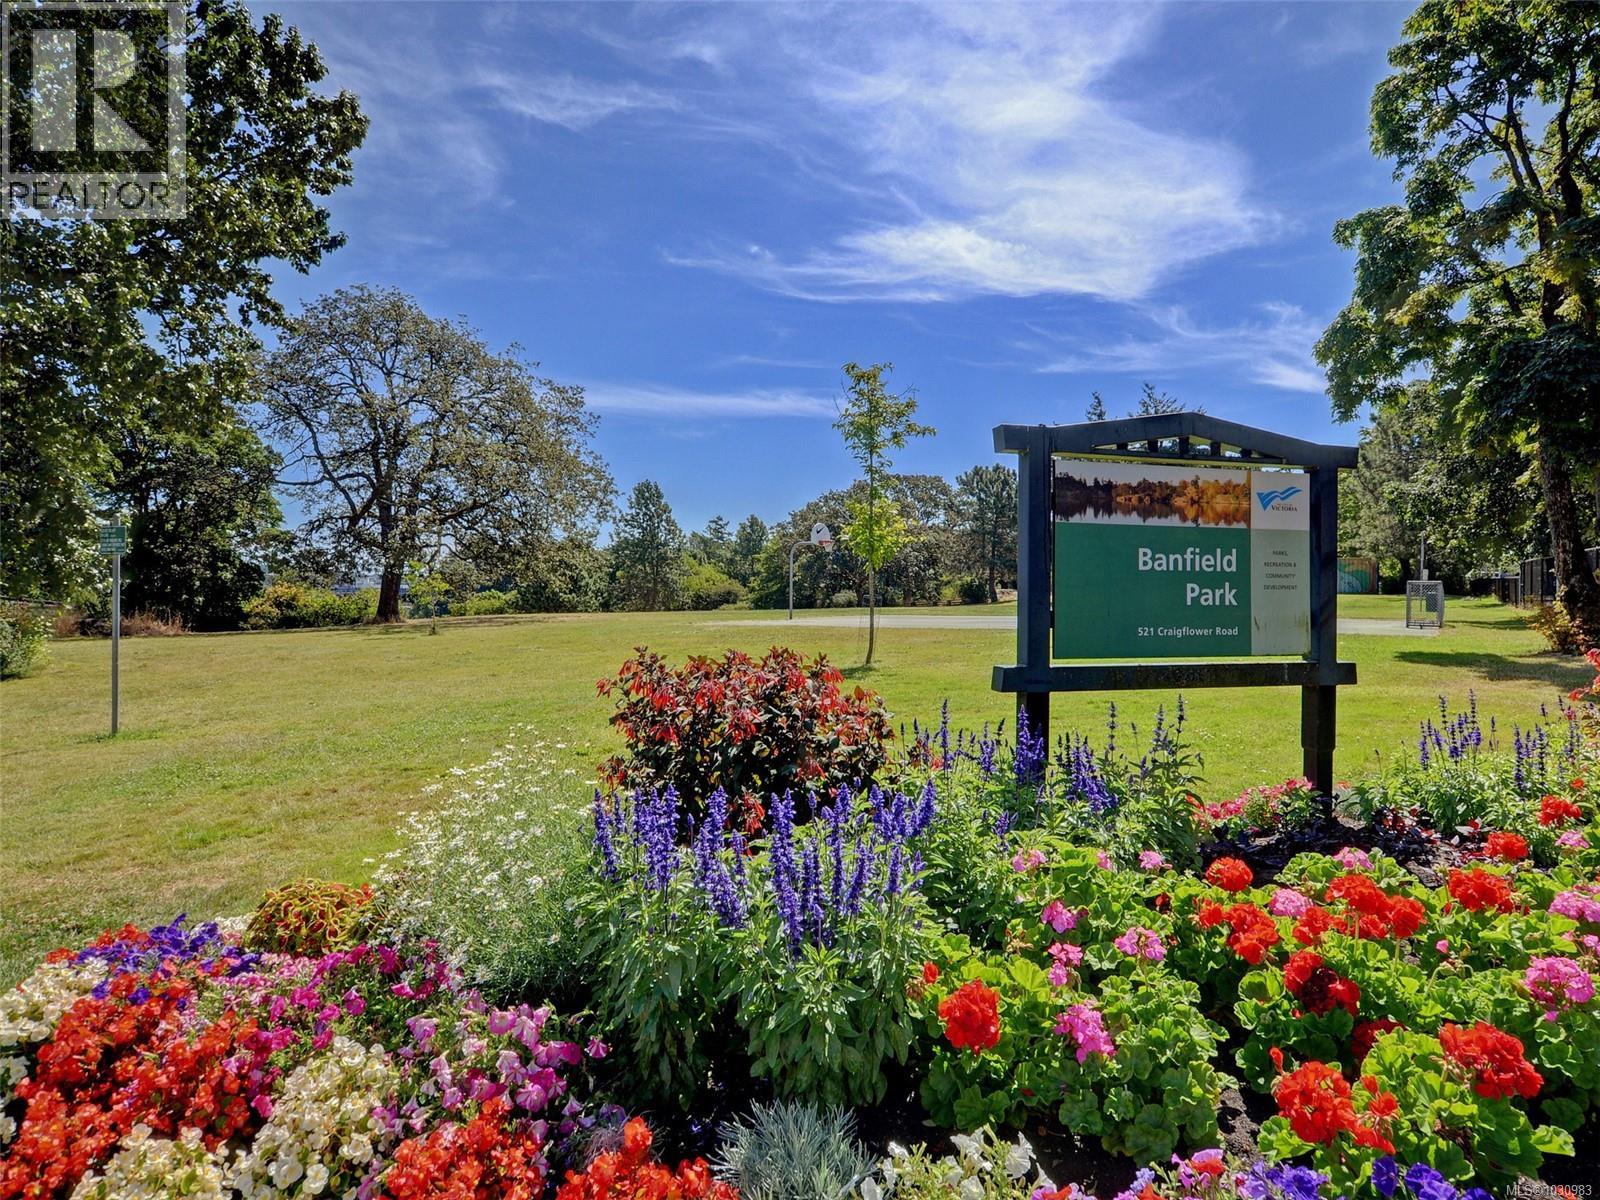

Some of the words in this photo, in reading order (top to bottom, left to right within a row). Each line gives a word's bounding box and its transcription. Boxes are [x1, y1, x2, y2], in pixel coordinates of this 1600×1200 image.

[1138, 547, 1237, 572] Banfield
[1186, 582, 1238, 606] Park
[1137, 627, 1155, 636] 521
[1157, 626, 1213, 638] Craigflower
[1215, 626, 1239, 636] Road
